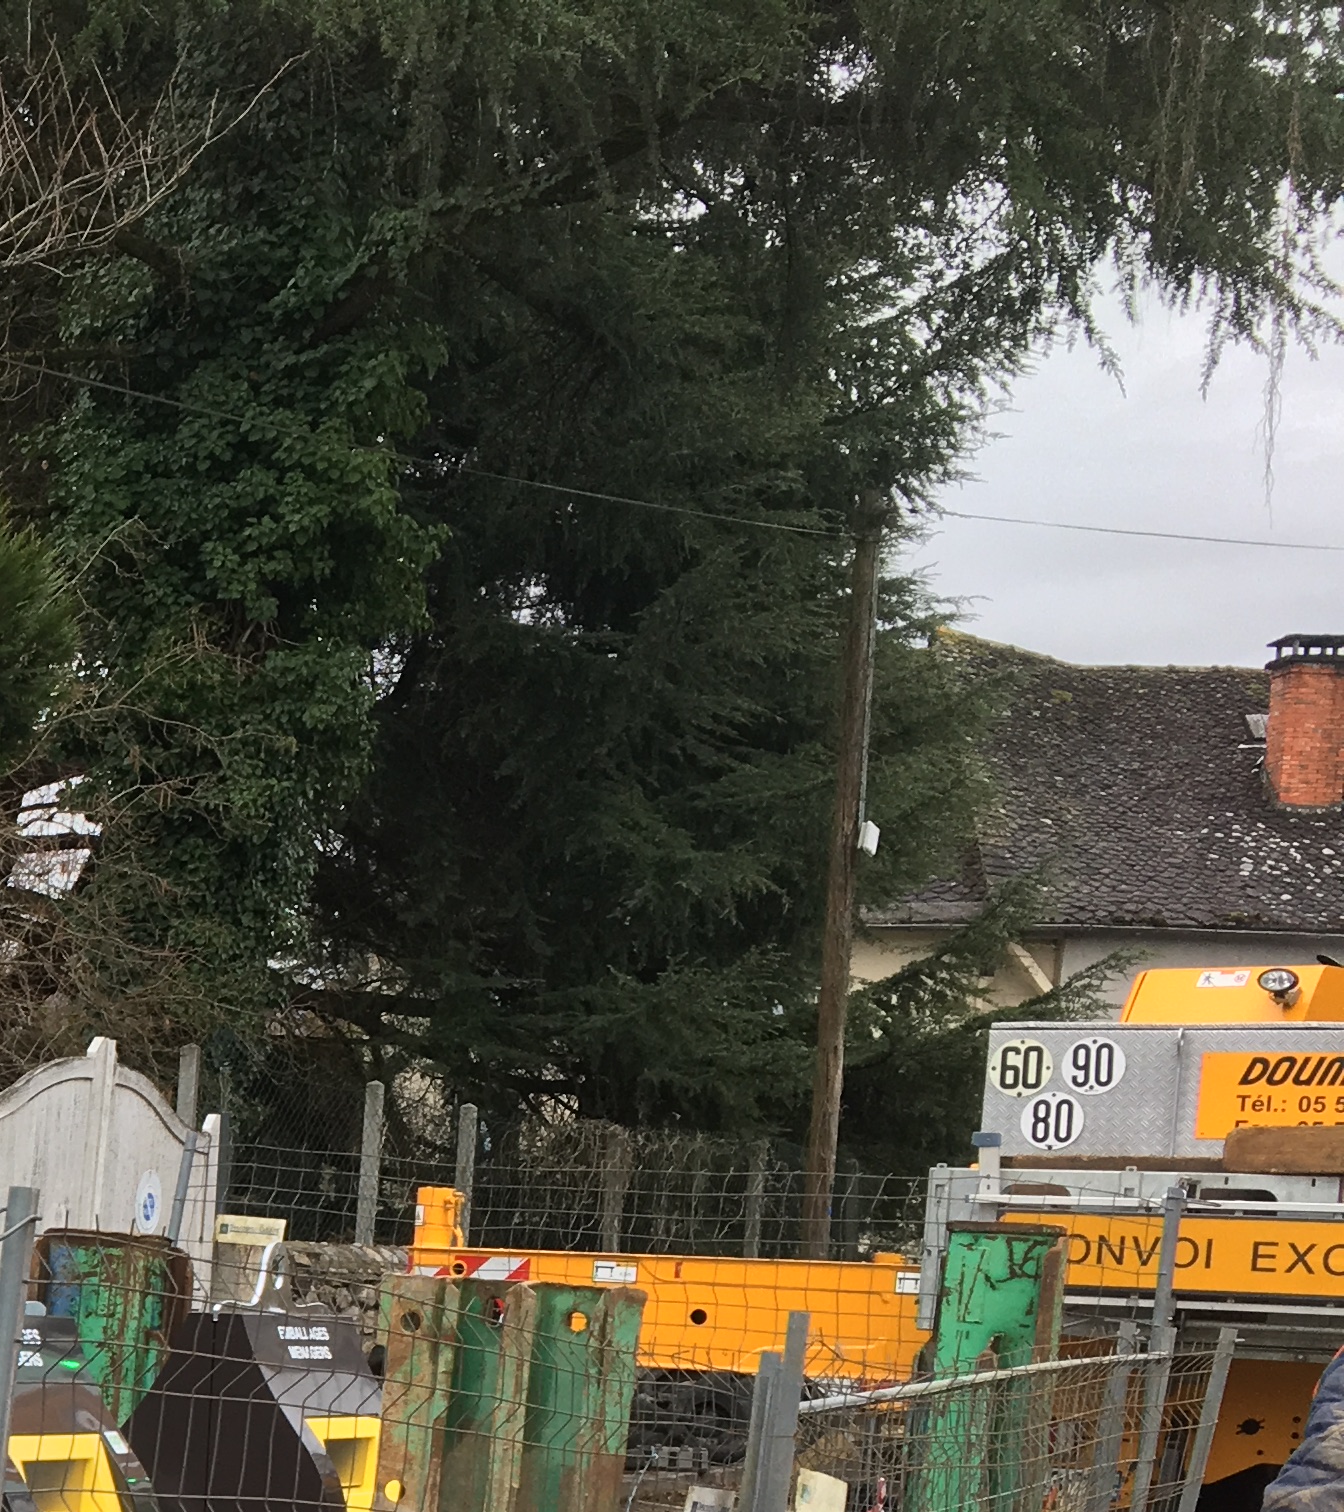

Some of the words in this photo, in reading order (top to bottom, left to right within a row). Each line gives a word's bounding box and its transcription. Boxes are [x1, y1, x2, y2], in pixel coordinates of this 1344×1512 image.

[999, 1045, 1044, 1090] 60
[1071, 1042, 1114, 1088] 90
[1031, 1098, 1074, 1143] 80
[1297, 1095, 1327, 1114] 05
[1066, 1233, 1214, 1270] ONVOI
